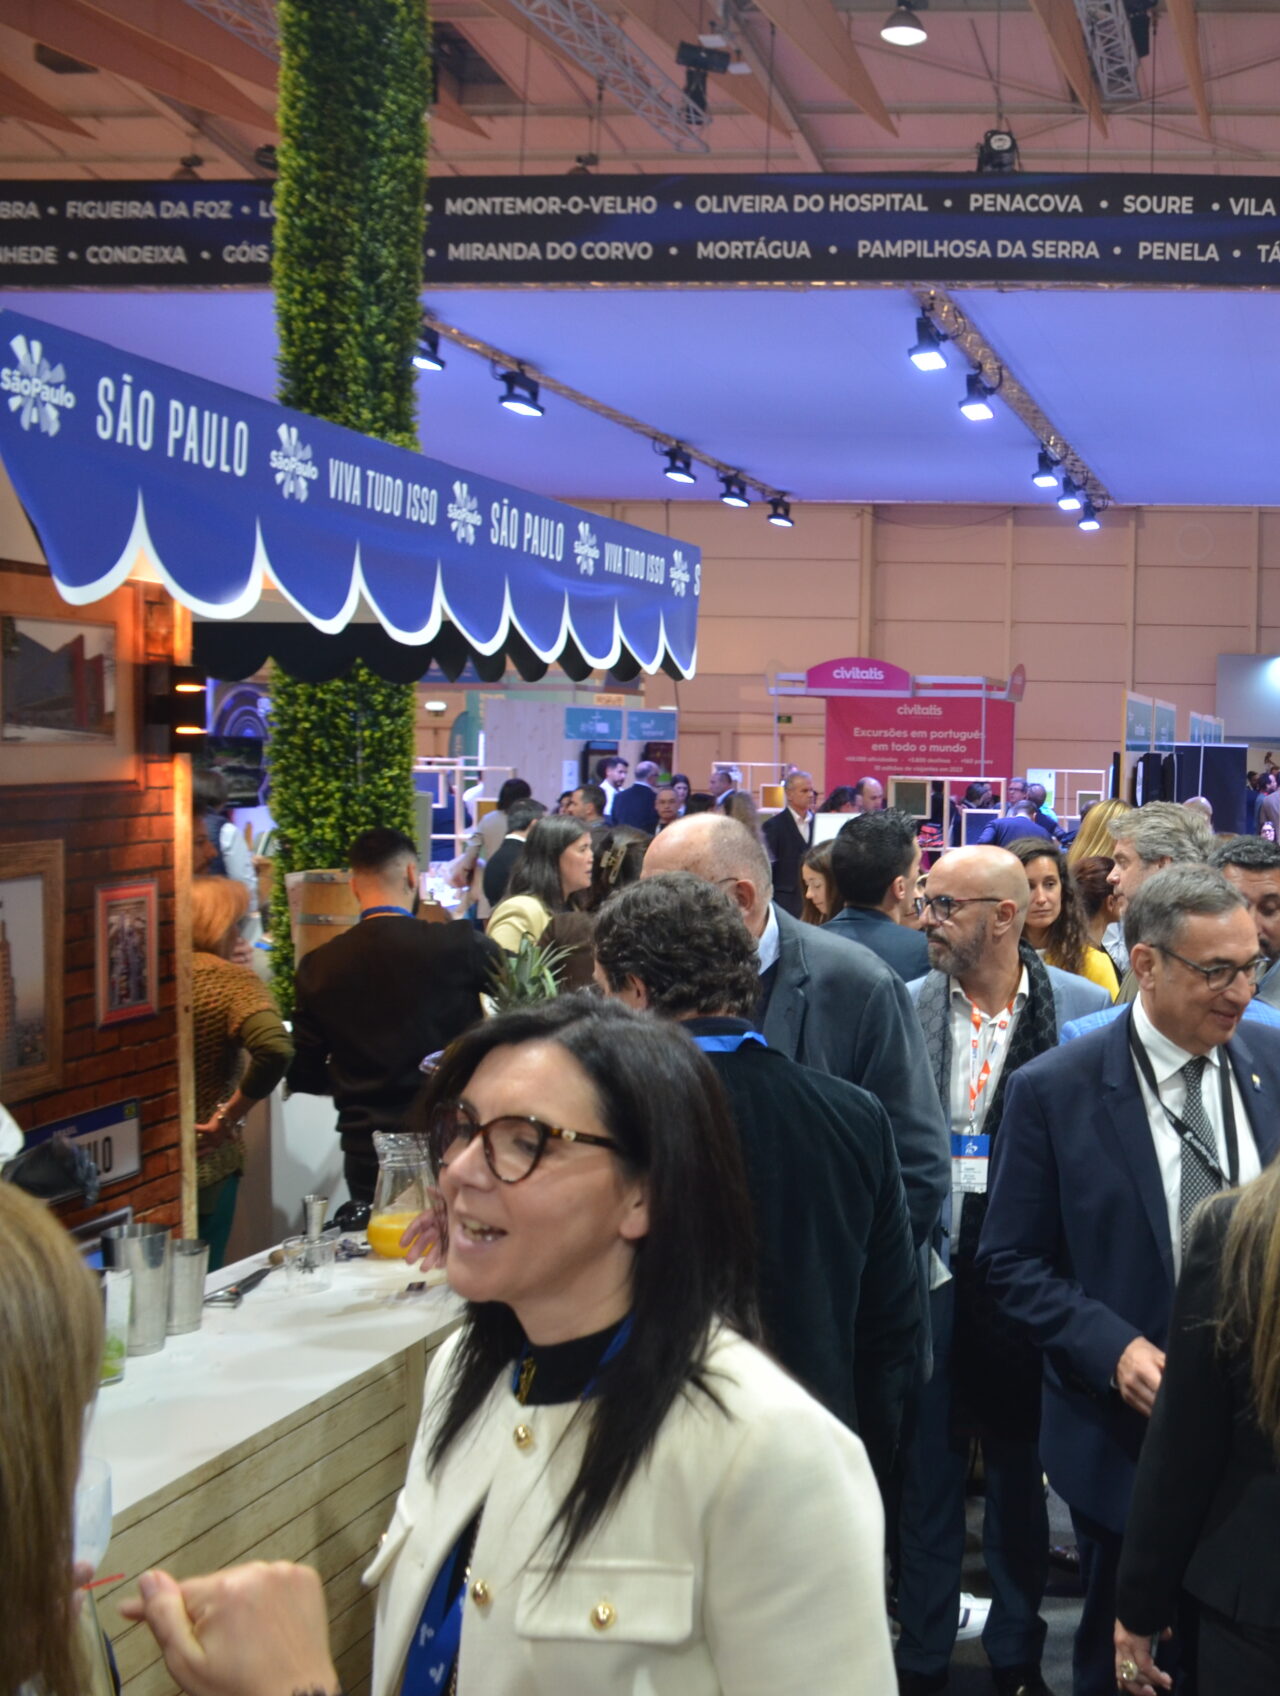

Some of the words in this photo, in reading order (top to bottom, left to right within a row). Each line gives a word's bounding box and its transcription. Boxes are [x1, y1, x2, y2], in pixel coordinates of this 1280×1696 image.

[66, 200, 157, 219] FIGUEIRA
[159, 200, 190, 219] DA
[193, 200, 233, 219] FOZ
[445, 195, 658, 216] MONTEMOR-O-VELHO
[695, 194, 789, 214] OLIVEIRA
[793, 194, 825, 213] DO
[829, 193, 929, 213] HOSPITAL
[969, 193, 1084, 213] PENACOVA
[1123, 194, 1194, 215] SOURE
[1228, 197, 1277, 217] VILA
[86, 245, 188, 264] CONDEIXA
[222, 241, 270, 264] GÓIS
[448, 242, 542, 261] MIRANDA
[546, 241, 578, 260] DO
[580, 241, 653, 260] CORVO
[696, 236, 812, 260] MORTÁGUA
[857, 239, 992, 259] PAMPILHOSA
[996, 239, 1028, 259] DA
[1031, 239, 1100, 259] SERRA
[1138, 241, 1220, 262] PENELA
[95, 373, 155, 451] SÃO
[166, 398, 250, 478] PAULO
[328, 457, 362, 506] VIVA
[365, 469, 403, 517] TUDO
[405, 482, 438, 526] ISSO
[490, 497, 519, 550] SÃO
[522, 512, 564, 562] PAULO
[604, 541, 623, 575] VIVA
[624, 546, 646, 580] TUDO
[645, 553, 666, 585] ISSO
[832, 666, 885, 680] civitatis
[896, 704, 943, 717] civitatis
[853, 727, 908, 738] Excursões
